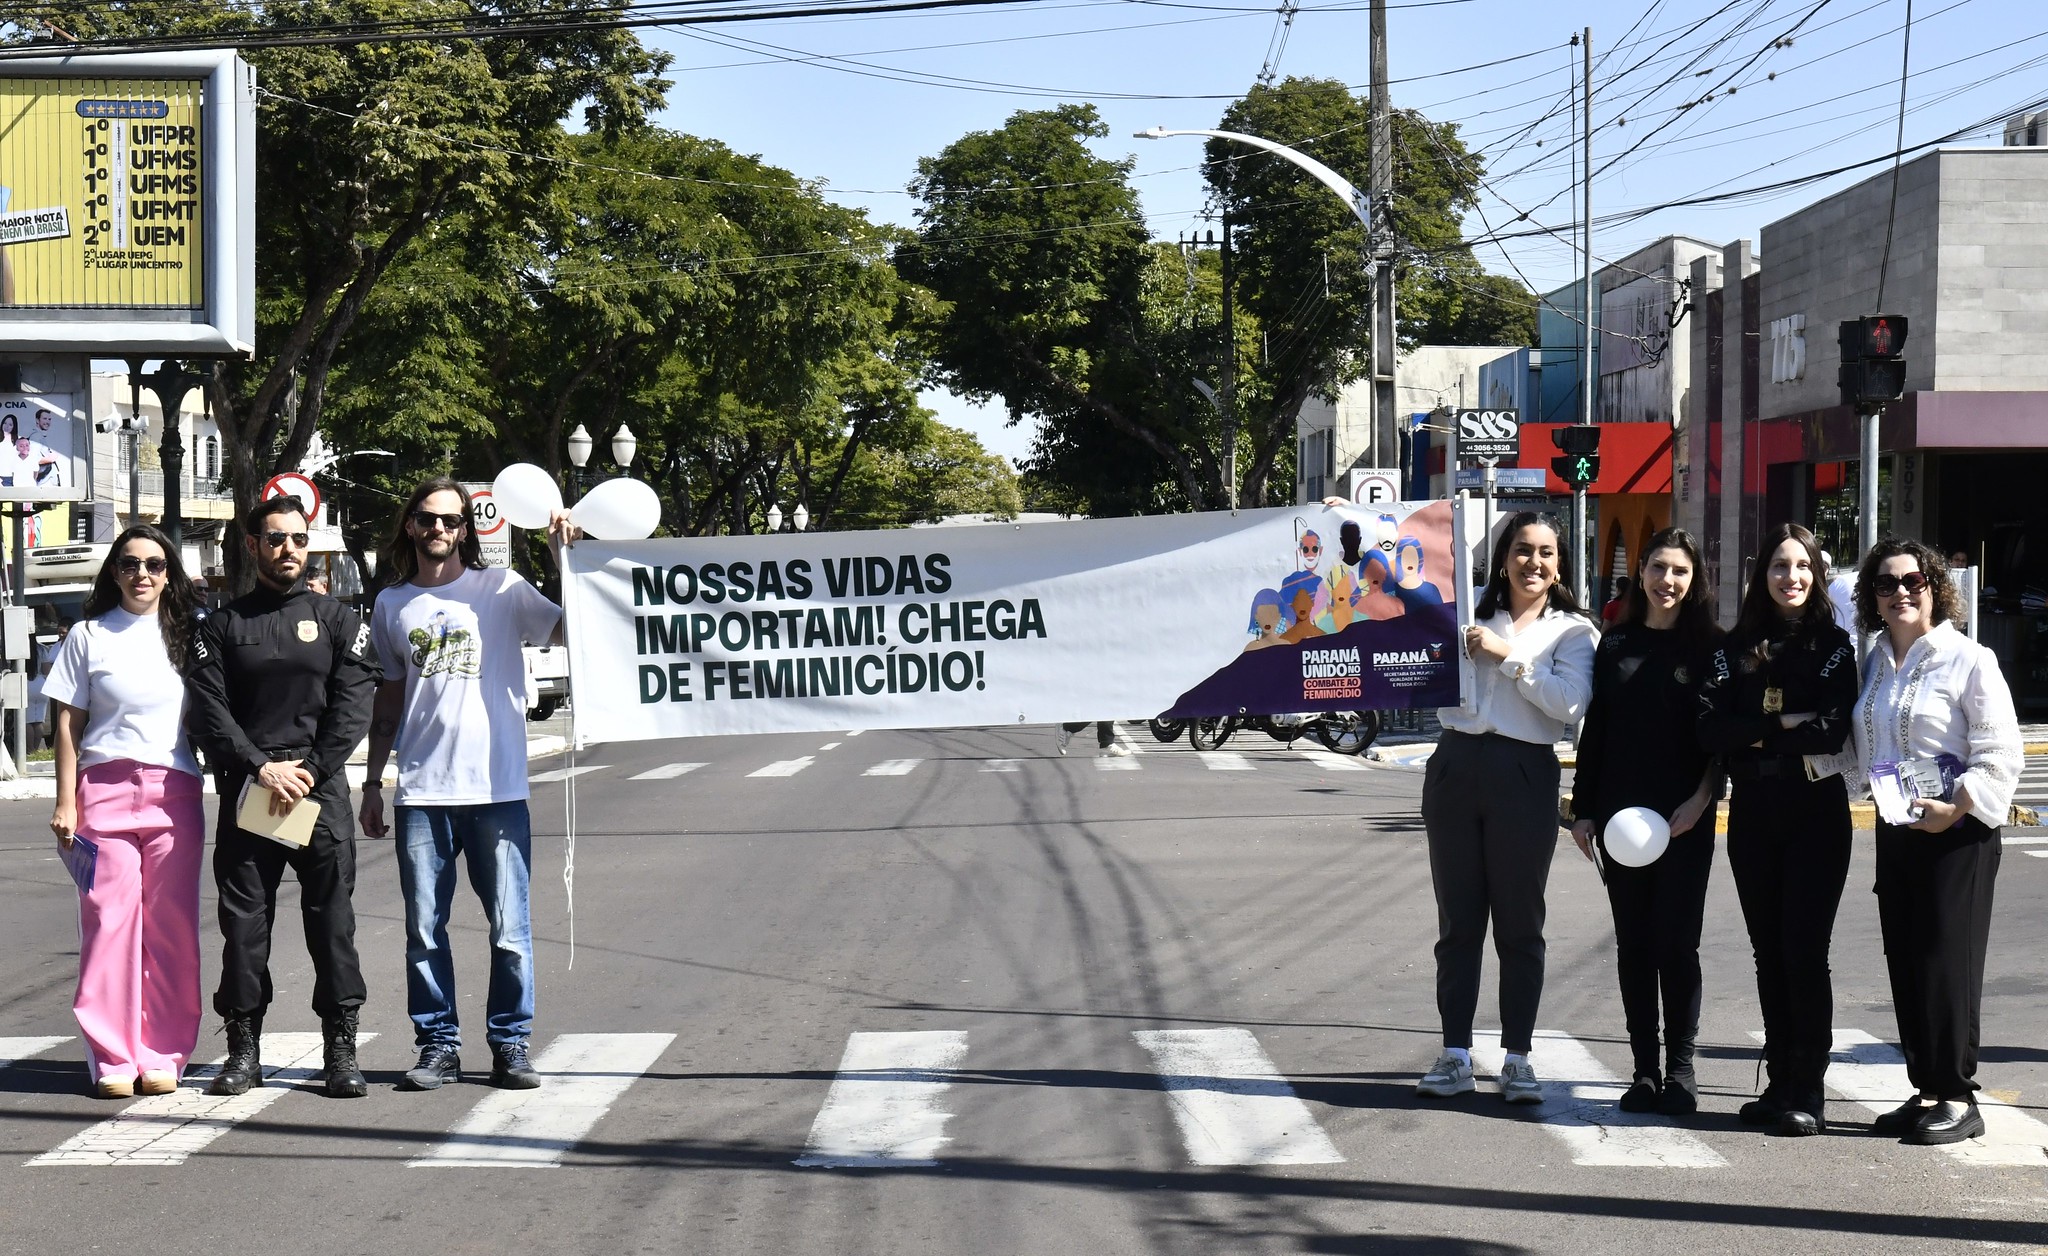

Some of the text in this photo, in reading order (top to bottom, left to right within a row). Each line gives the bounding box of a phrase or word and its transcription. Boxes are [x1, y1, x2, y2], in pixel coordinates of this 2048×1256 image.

[132, 125, 196, 145] UFPR
[131, 150, 197, 170] UFMS
[131, 175, 197, 194] UFMS
[34, 212, 63, 224] NOTA
[132, 201, 197, 220] UFMT
[24, 225, 35, 236] NO
[37, 221, 65, 234] BRASIL
[134, 226, 185, 246] UEM
[95, 251, 125, 259] LUGAR
[97, 261, 127, 269] LUGAR
[130, 261, 183, 269] UNICENTRO
[5, 401, 27, 409] CNA
[1460, 411, 1517, 439] S&S
[1458, 476, 1480, 485] PARANÁ
[1497, 475, 1538, 484] ROLÂNDIA
[473, 502, 497, 520] 40
[632, 553, 952, 606] NOSSAS VIDAS
[635, 598, 1047, 655] IMPORTAM! CHEGA
[351, 622, 371, 657] PCPR
[1302, 646, 1360, 664] PARANÁ
[1373, 649, 1429, 665] PARANÁ
[1820, 646, 1850, 678] PCPR
[1302, 663, 1361, 678] UNIDO NO
[1713, 649, 1730, 680] PCPR
[638, 646, 986, 704] DE FEMINICÍDIO!
[1306, 678, 1359, 688] COMBATE AO
[1304, 688, 1361, 700] FEMINICÍDIO
